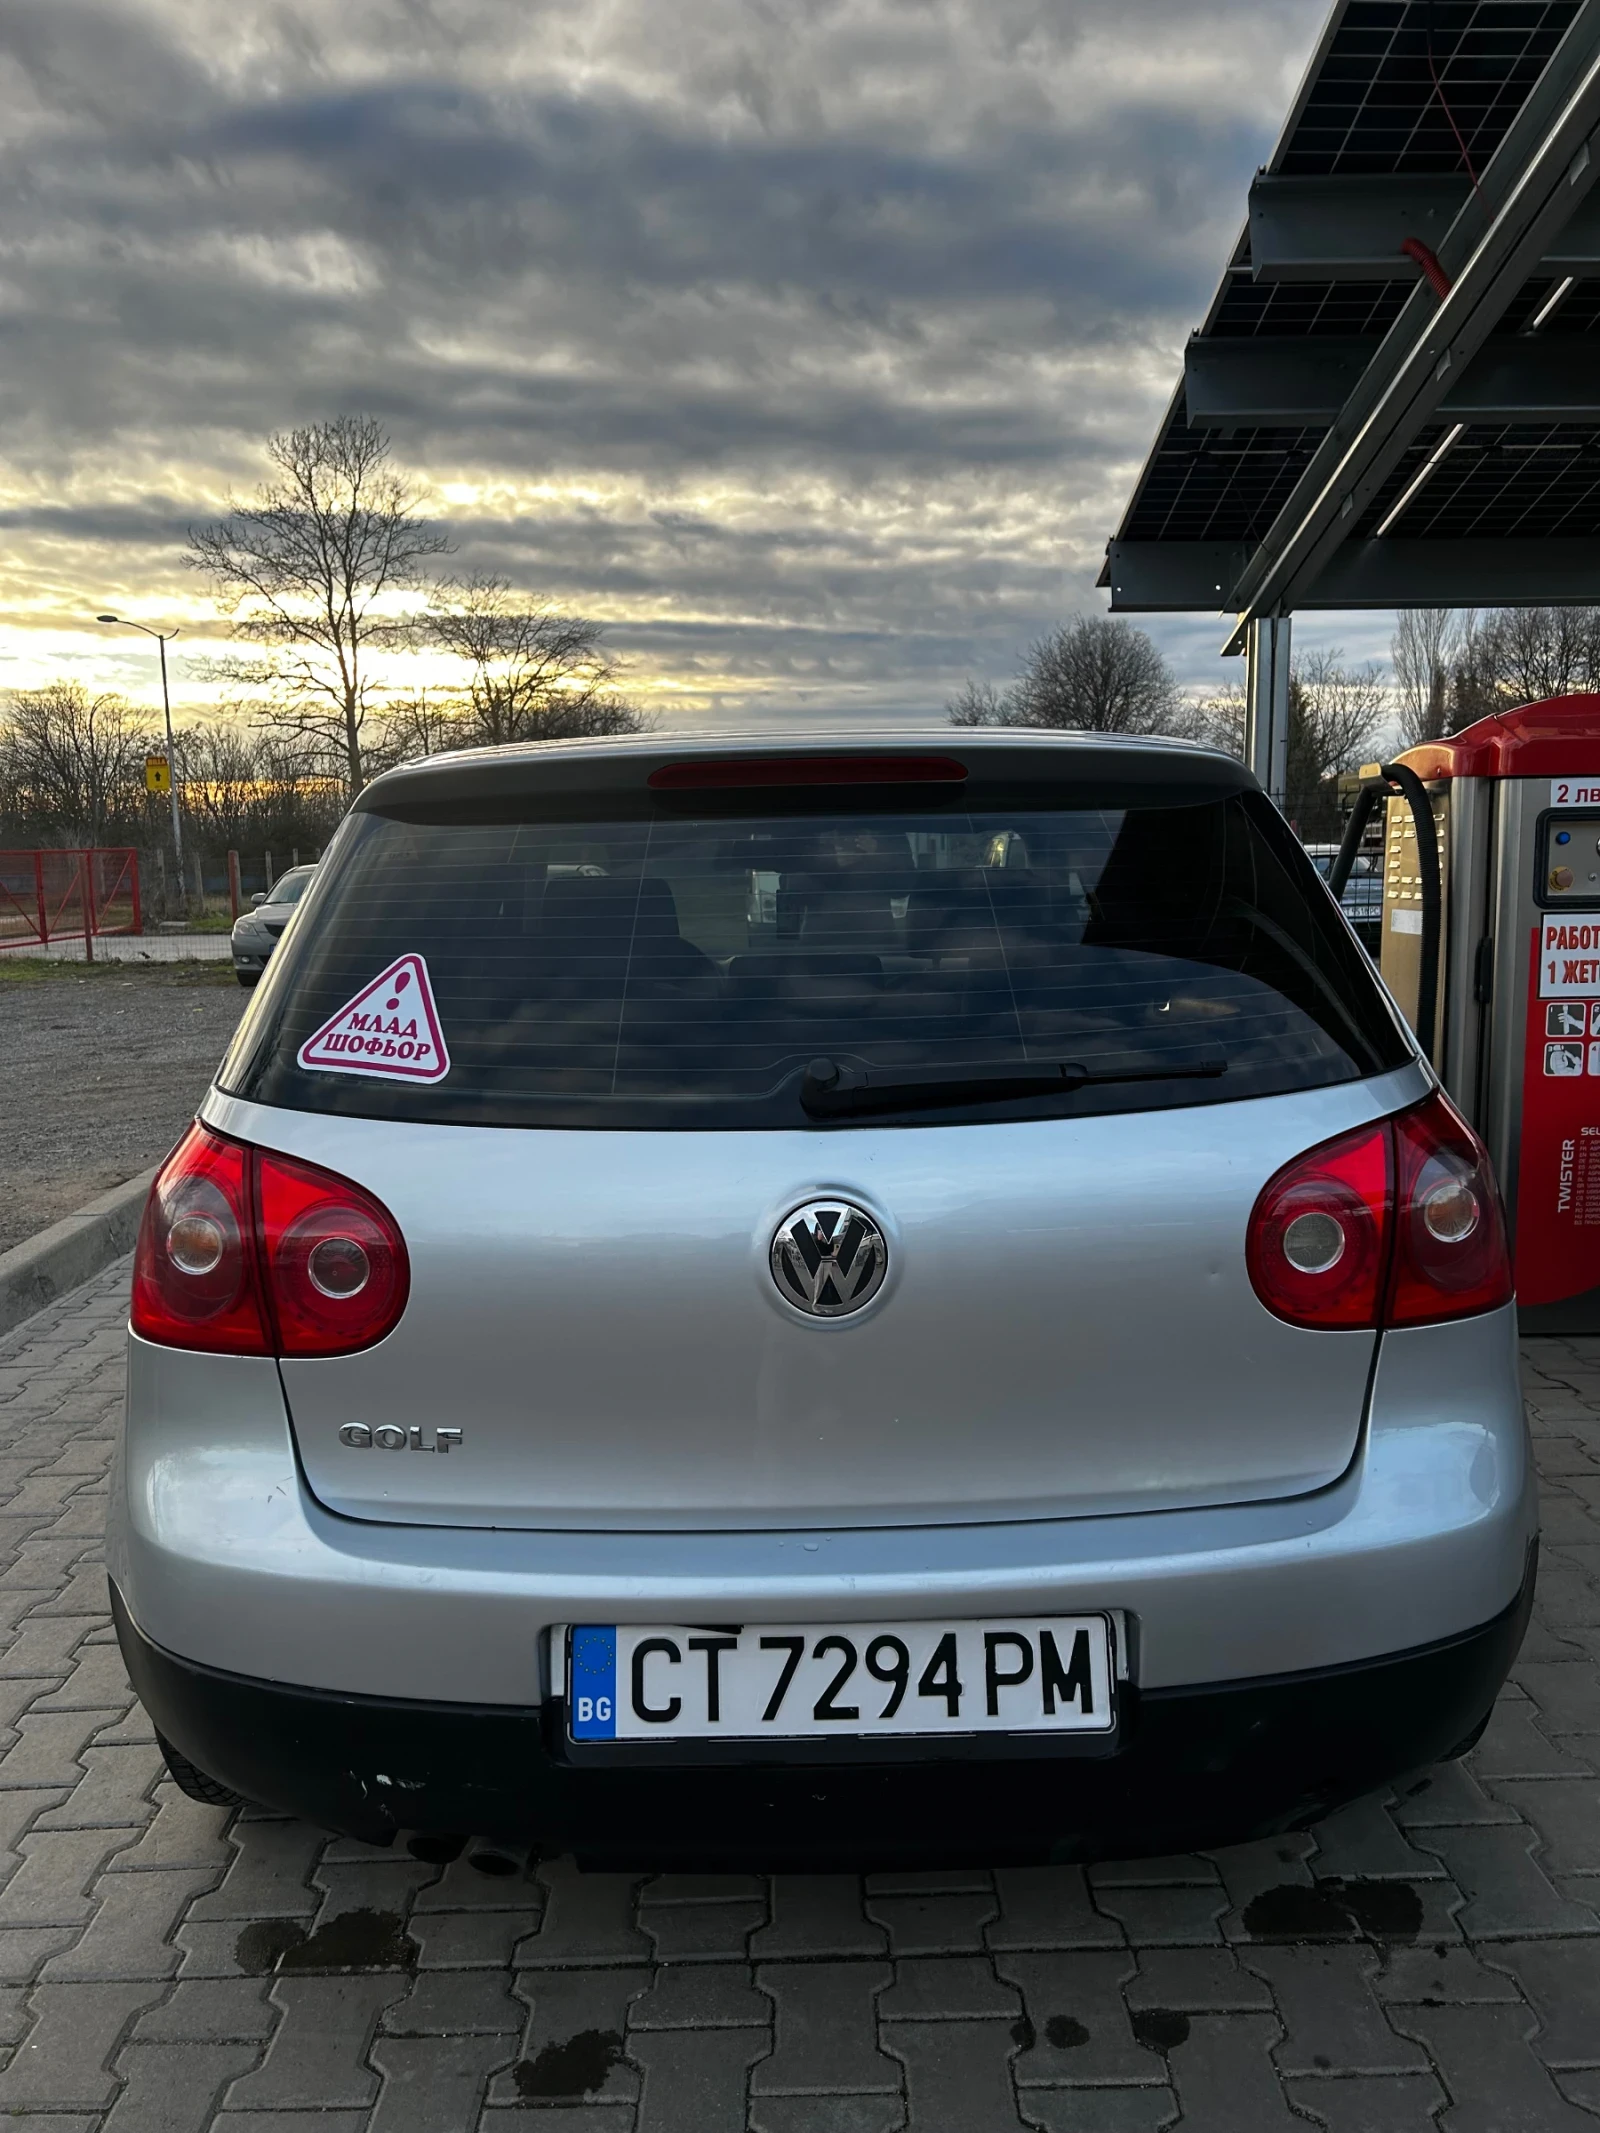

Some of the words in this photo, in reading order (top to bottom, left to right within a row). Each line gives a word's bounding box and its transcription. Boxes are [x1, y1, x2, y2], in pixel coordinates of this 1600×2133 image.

[1556, 784, 1569, 803] 2
[1575, 788, 1600, 803] лв
[1546, 926, 1600, 950] РАБОТ
[1547, 961, 1556, 984] 1
[1562, 960, 1600, 984] ЖЕТ
[347, 1013, 418, 1039] МЛАД
[323, 1033, 431, 1060] ШОФЬОР
[1557, 1139, 1576, 1213] TWISTER
[338, 1421, 463, 1454] GOLF
[631, 1636, 739, 1723] CT
[759, 1632, 963, 1721] 7294
[984, 1629, 1094, 1716] PM
[578, 1696, 611, 1722] BG
